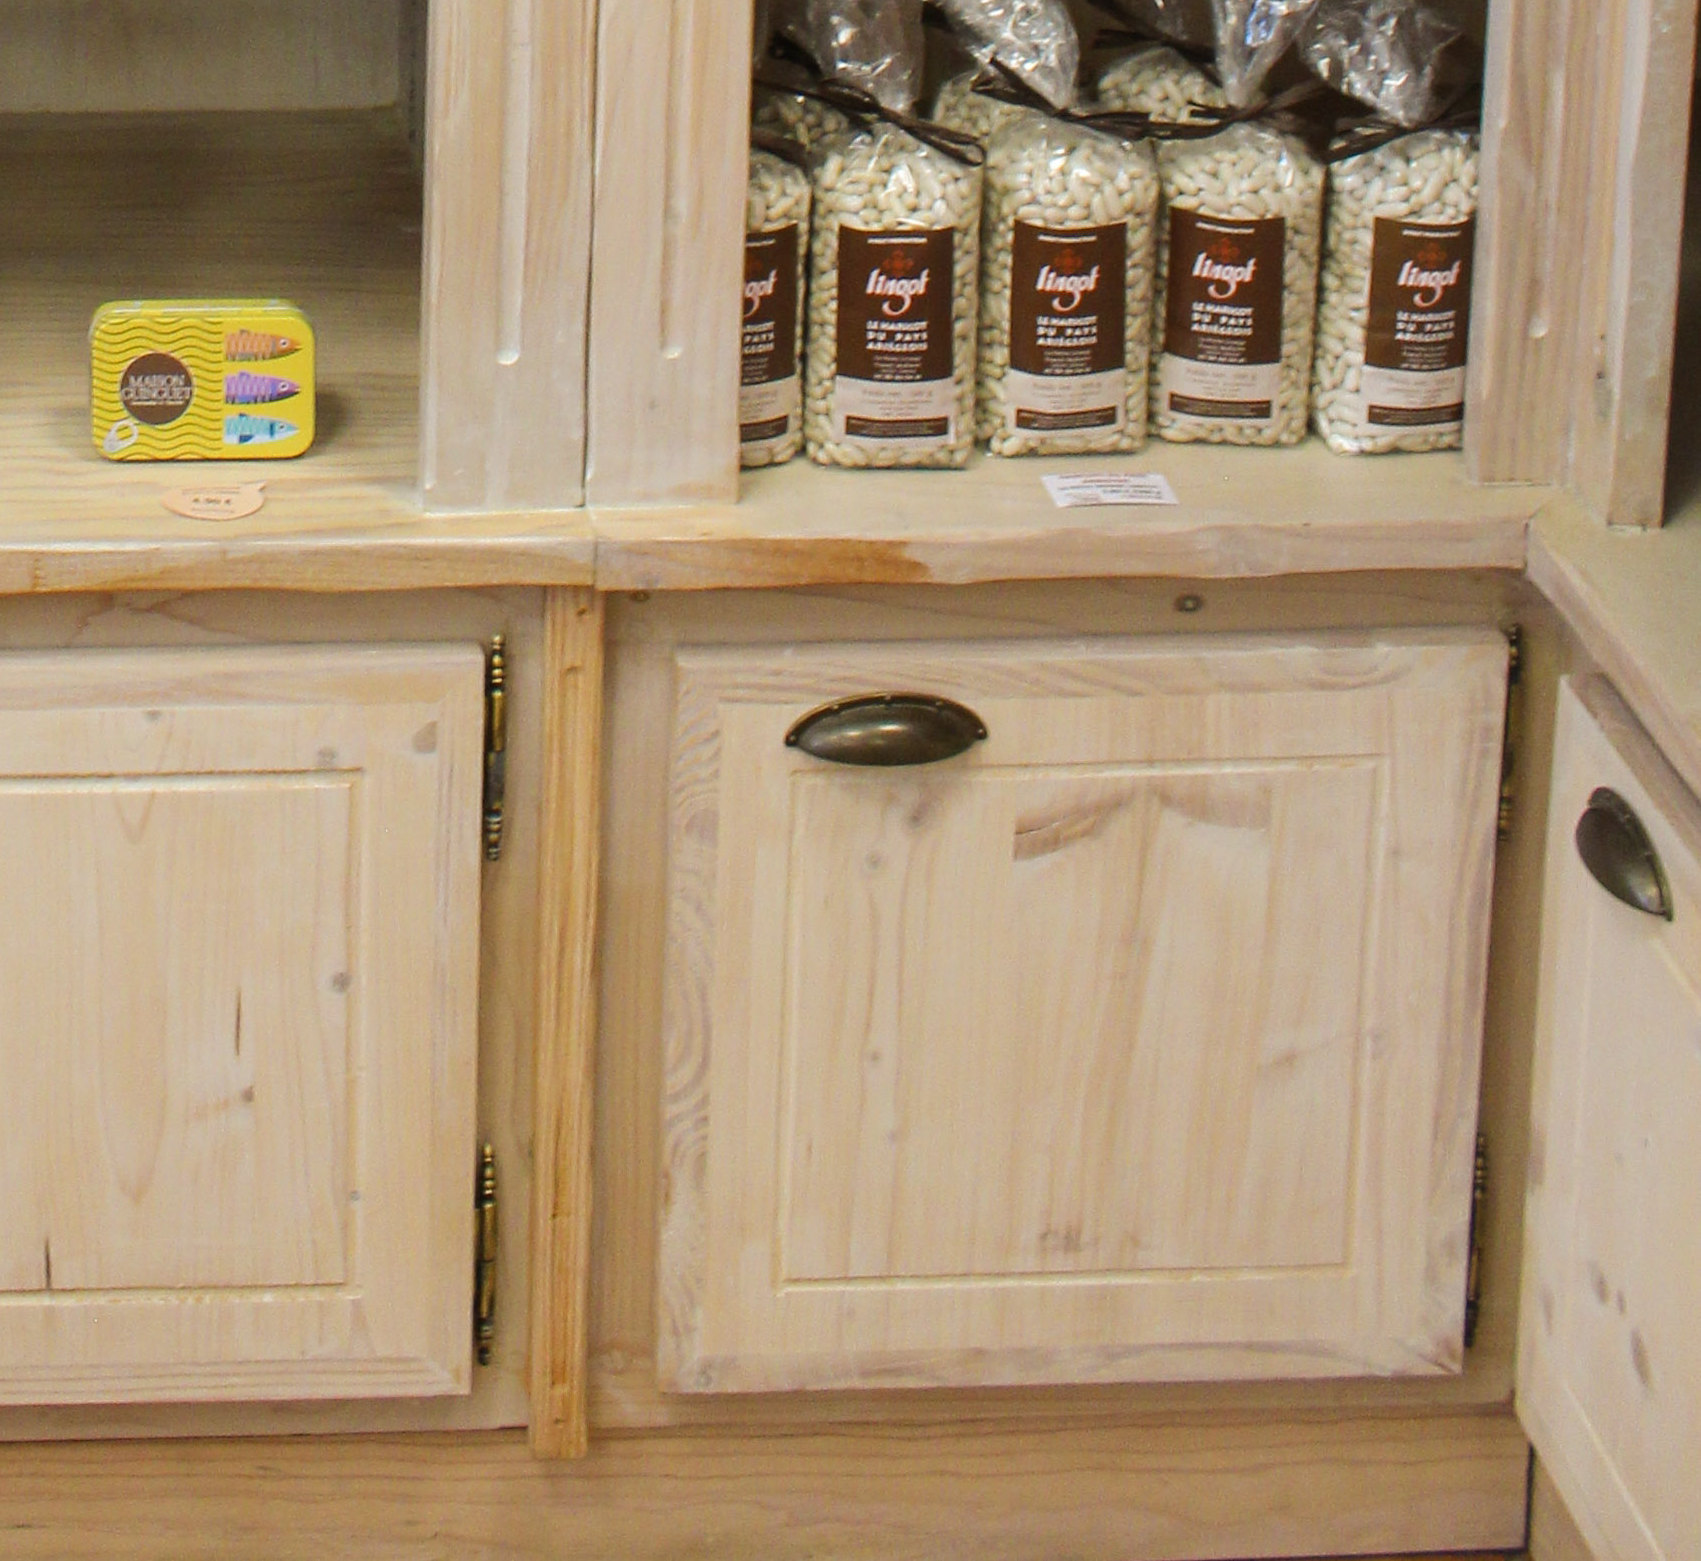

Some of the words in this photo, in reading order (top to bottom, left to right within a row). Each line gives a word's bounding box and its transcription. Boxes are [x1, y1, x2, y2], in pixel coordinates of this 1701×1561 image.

[866, 268, 930, 317] lingot
[1035, 264, 1101, 312] lingot
[1192, 251, 1258, 300] lingot
[1397, 260, 1462, 308] lingot
